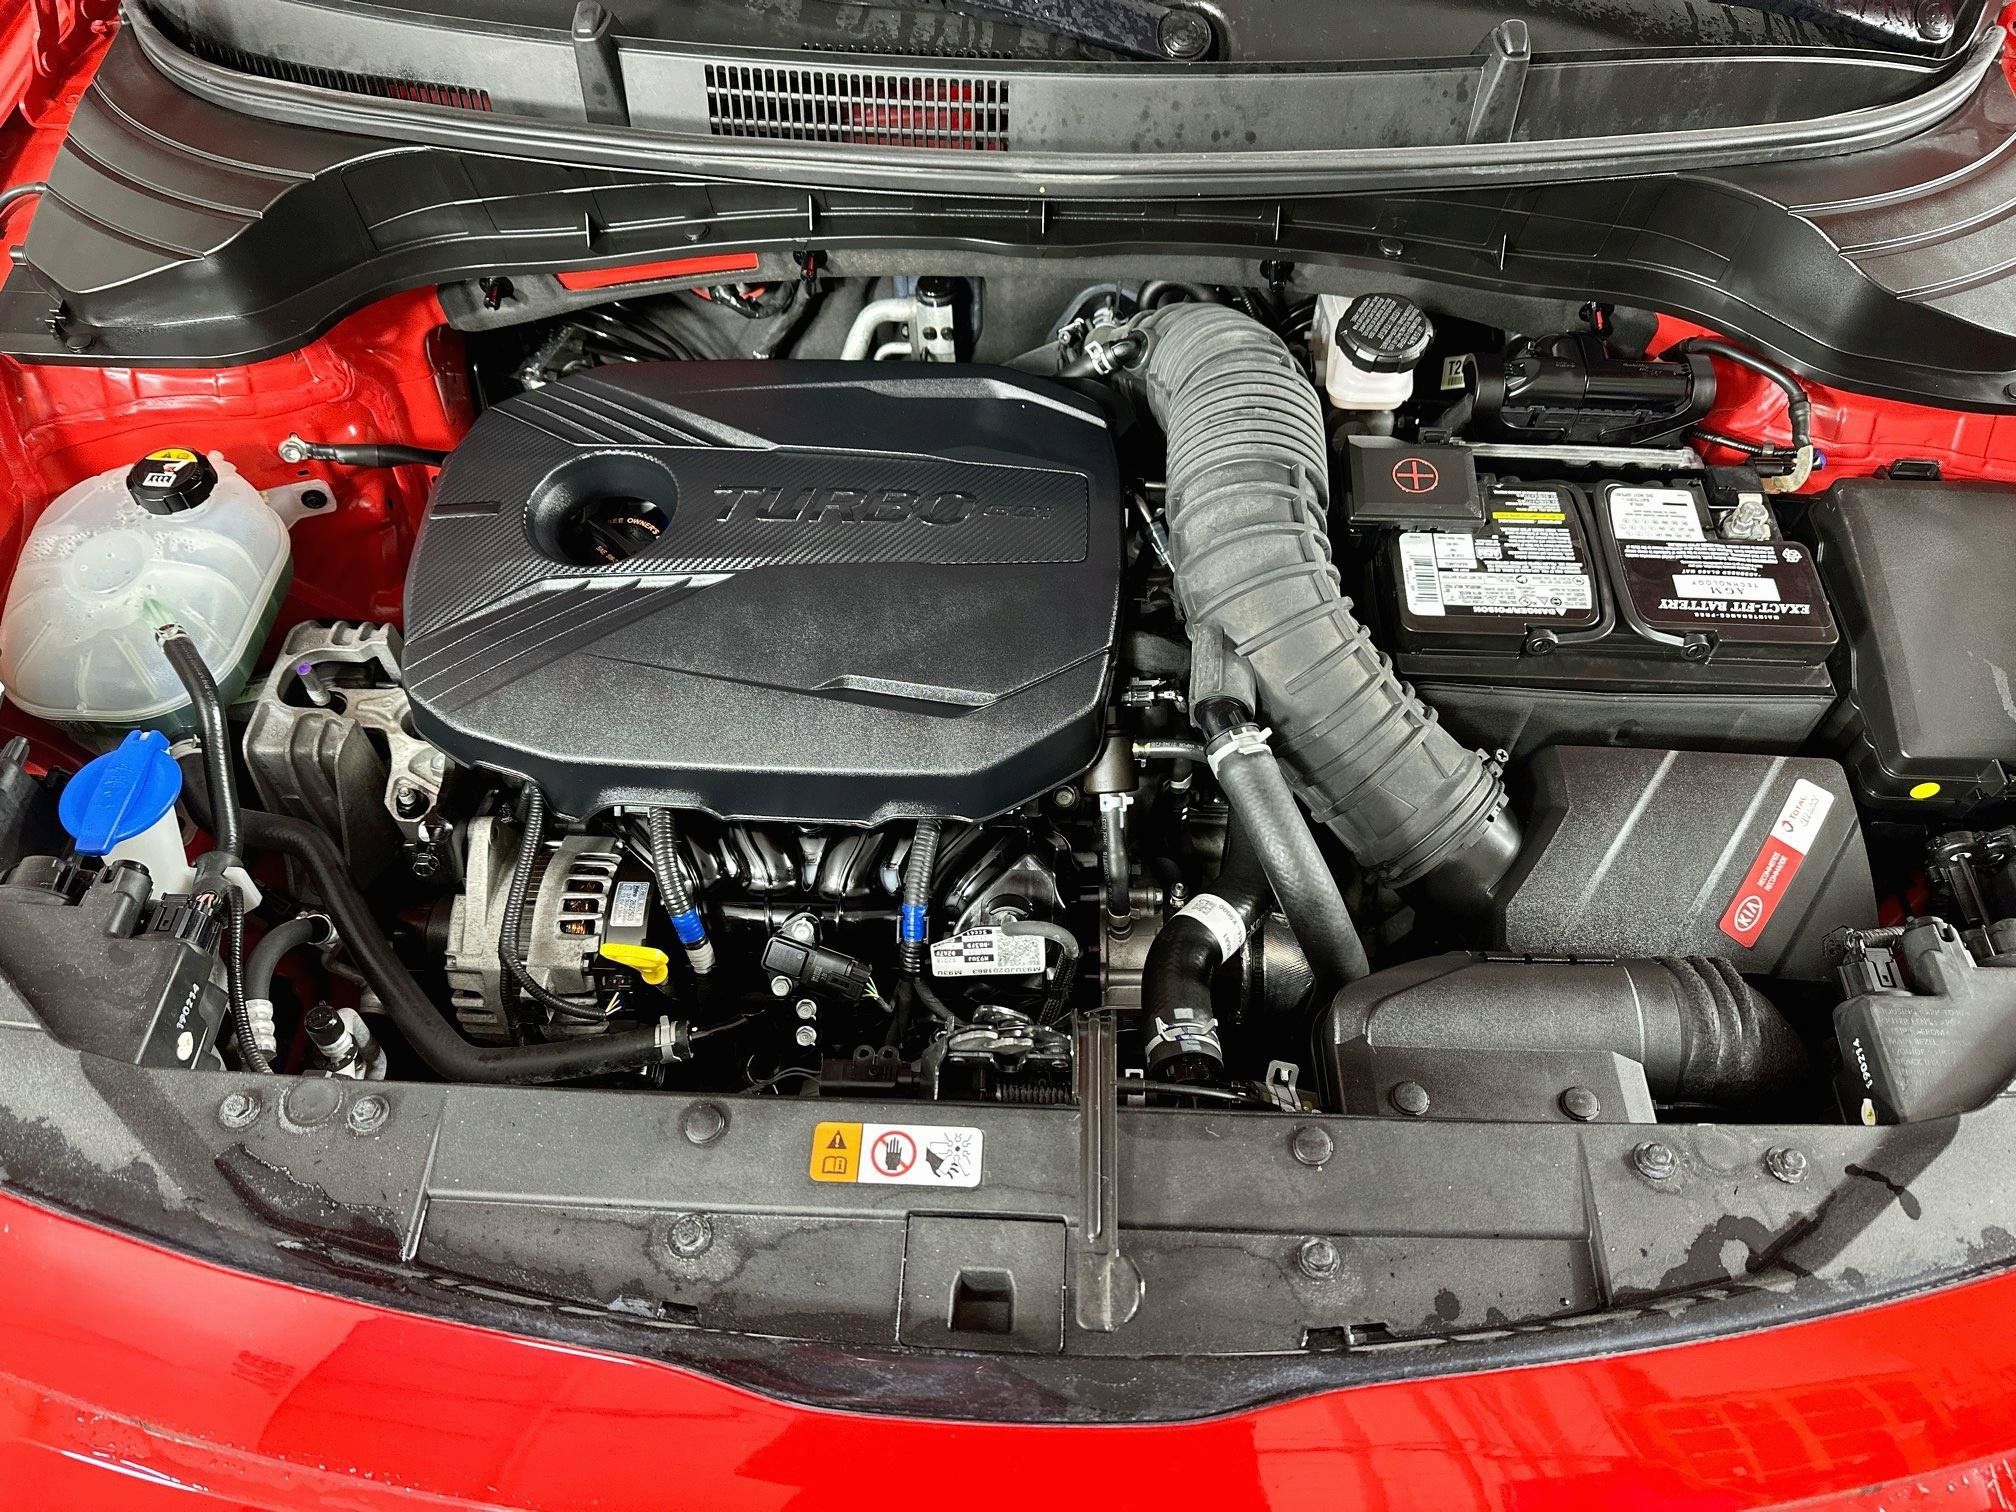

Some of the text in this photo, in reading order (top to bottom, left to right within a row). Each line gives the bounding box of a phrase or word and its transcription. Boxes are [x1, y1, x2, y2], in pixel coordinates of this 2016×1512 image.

[1448, 361, 1462, 376] T2
[713, 486, 978, 525] TURBO
[1692, 580, 1759, 588] TECHNOLOGY
[1710, 586, 1745, 595] AGM
[1658, 598, 1811, 614] EXACT-FIT BATTERY
[1790, 797, 1807, 819] TOTAL
[1736, 899, 1761, 928] KIA
[1853, 1038, 1874, 1090] 190214
